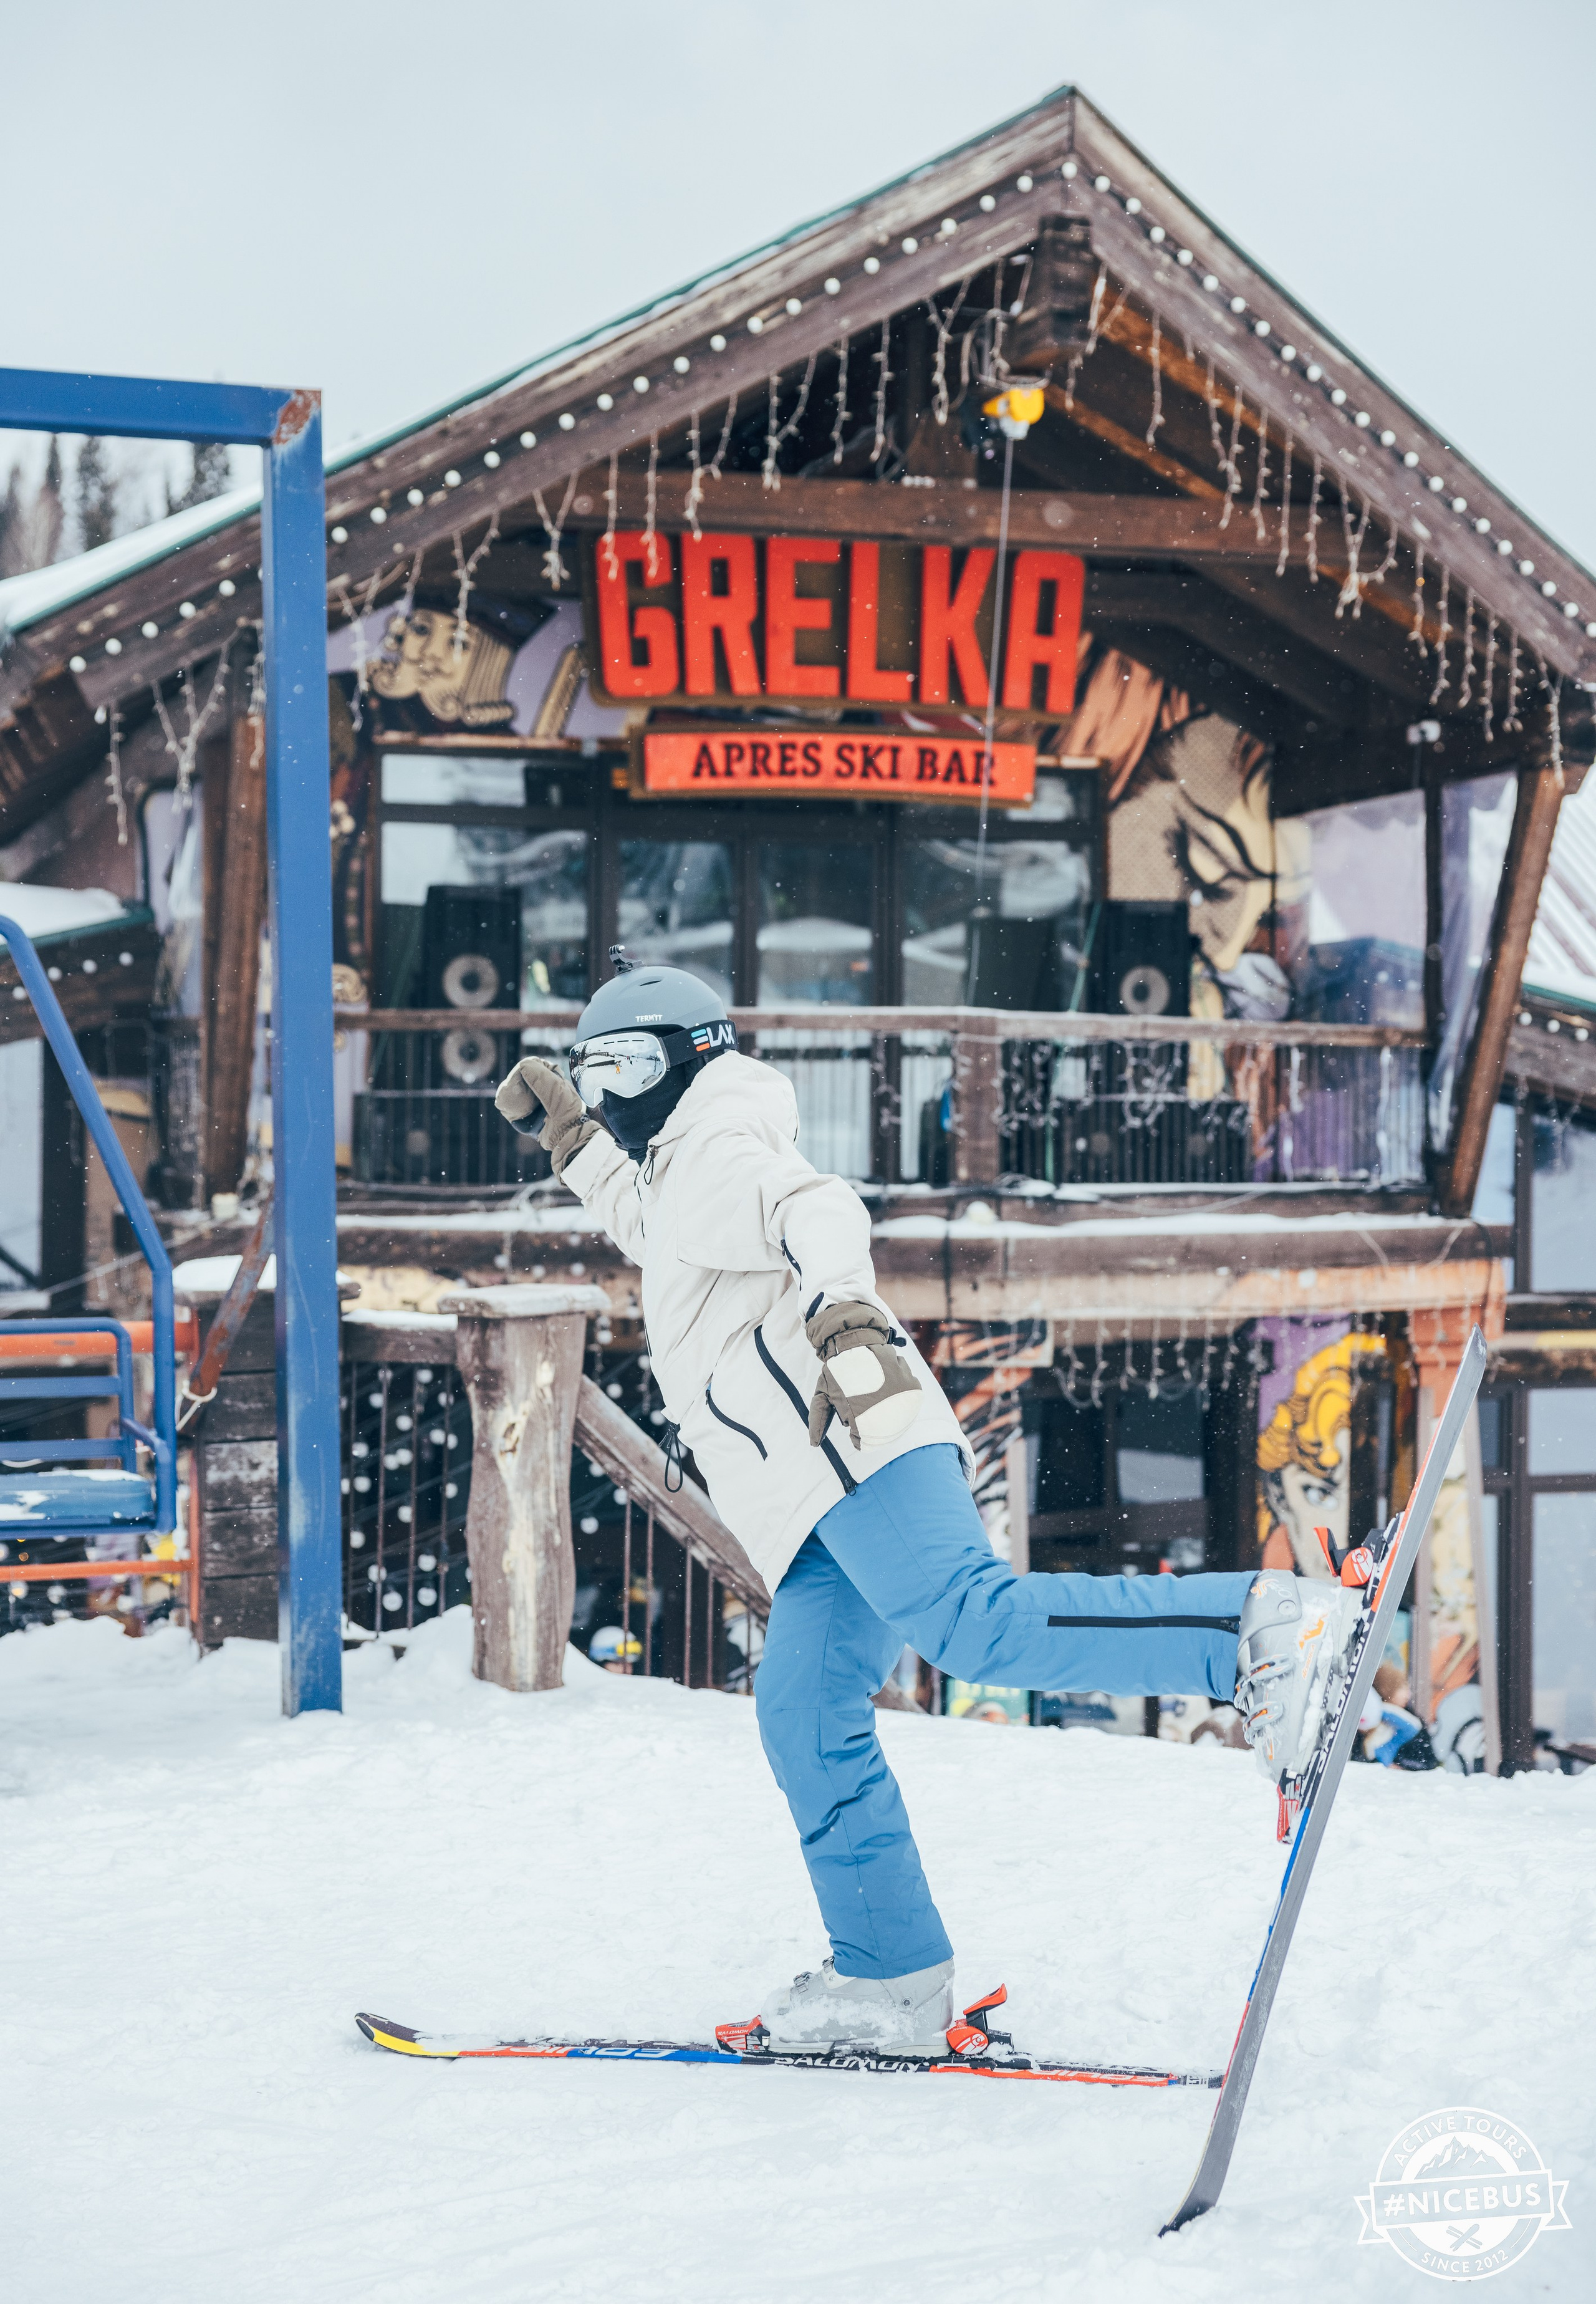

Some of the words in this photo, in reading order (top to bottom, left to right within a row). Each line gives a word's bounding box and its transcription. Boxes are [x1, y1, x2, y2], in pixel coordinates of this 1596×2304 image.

[595, 530, 1085, 715] GRELKA
[692, 742, 822, 778] APRES
[835, 743, 902, 780] SKI
[916, 747, 998, 786] BAR
[775, 2056, 921, 2072] SALOMON
